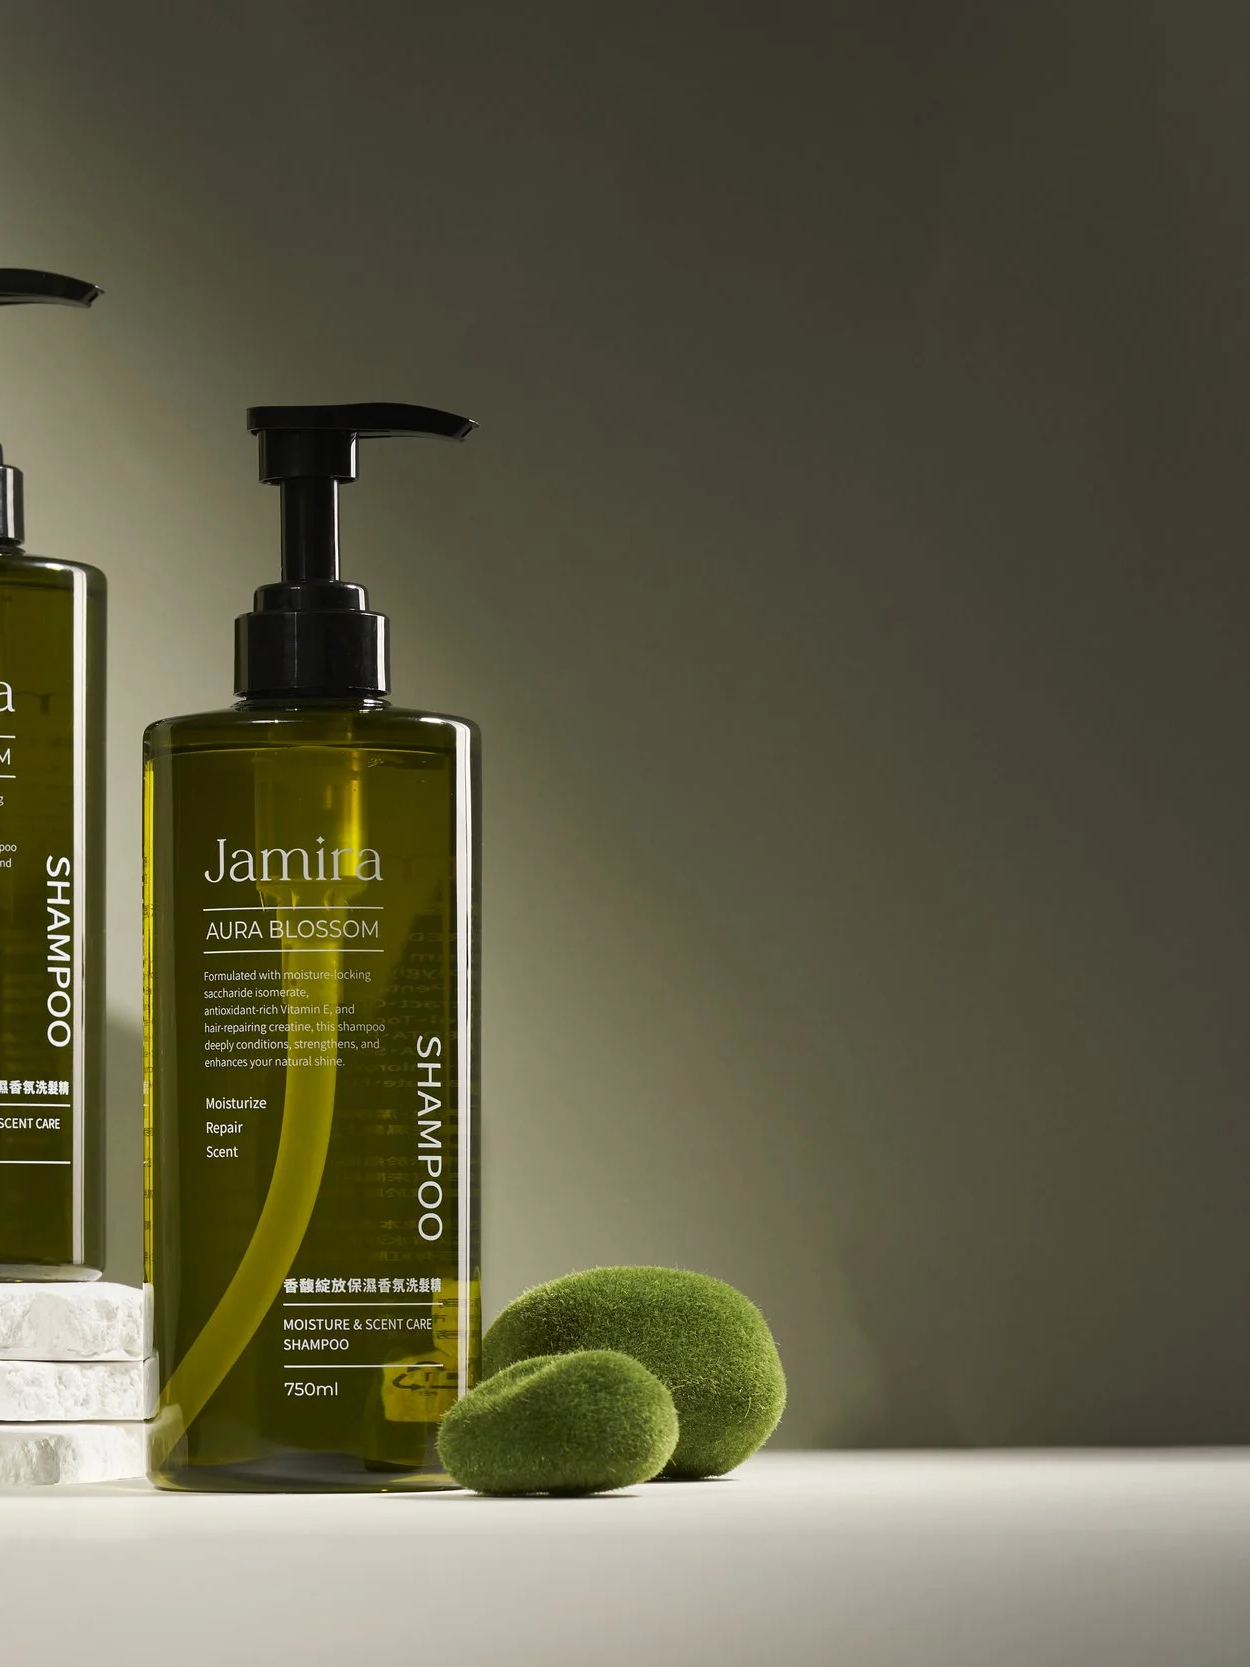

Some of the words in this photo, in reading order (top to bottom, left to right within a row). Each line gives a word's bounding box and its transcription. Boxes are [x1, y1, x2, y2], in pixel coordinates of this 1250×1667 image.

[205, 836, 383, 883] Jamira
[206, 921, 263, 940] AURA
[270, 920, 378, 938] BLOSSOM
[46, 856, 71, 1047] SHAMPOO
[204, 970, 256, 981] Formulated
[259, 970, 280, 980] with
[282, 970, 371, 982] moisture-locking
[204, 988, 252, 998] saccharide
[255, 988, 308, 998] isomerate,
[205, 1005, 279, 1016] antioxidant-rich
[280, 1003, 320, 1014] Vitamin
[323, 1004, 332, 1015] E,
[335, 1004, 354, 1014] and
[205, 1022, 267, 1035] hair-repairing
[269, 1022, 313, 1032] creatine,
[316, 1021, 335, 1031] this
[338, 1021, 385, 1033] shampoo
[205, 1040, 234, 1052] deeply
[236, 1039, 291, 1050] conditions,
[294, 1039, 358, 1051] strengthens,
[361, 1039, 379, 1049] and
[205, 1057, 248, 1067] enhances
[250, 1059, 272, 1069] your
[275, 1056, 311, 1066] natural
[315, 1056, 345, 1066] shine.
[206, 1097, 266, 1109] Moisturize
[36, 1118, 60, 1129] CARE
[207, 1121, 243, 1136] Repair
[417, 1036, 442, 1241] SHAMPOO
[207, 1146, 238, 1158] Scent
[284, 1319, 350, 1330] MOISTURE
[353, 1319, 362, 1330] &
[366, 1319, 403, 1330] SCENT
[407, 1319, 432, 1329] CARE
[284, 1339, 349, 1350] SHAMPOO
[285, 1382, 337, 1396] 750ml
